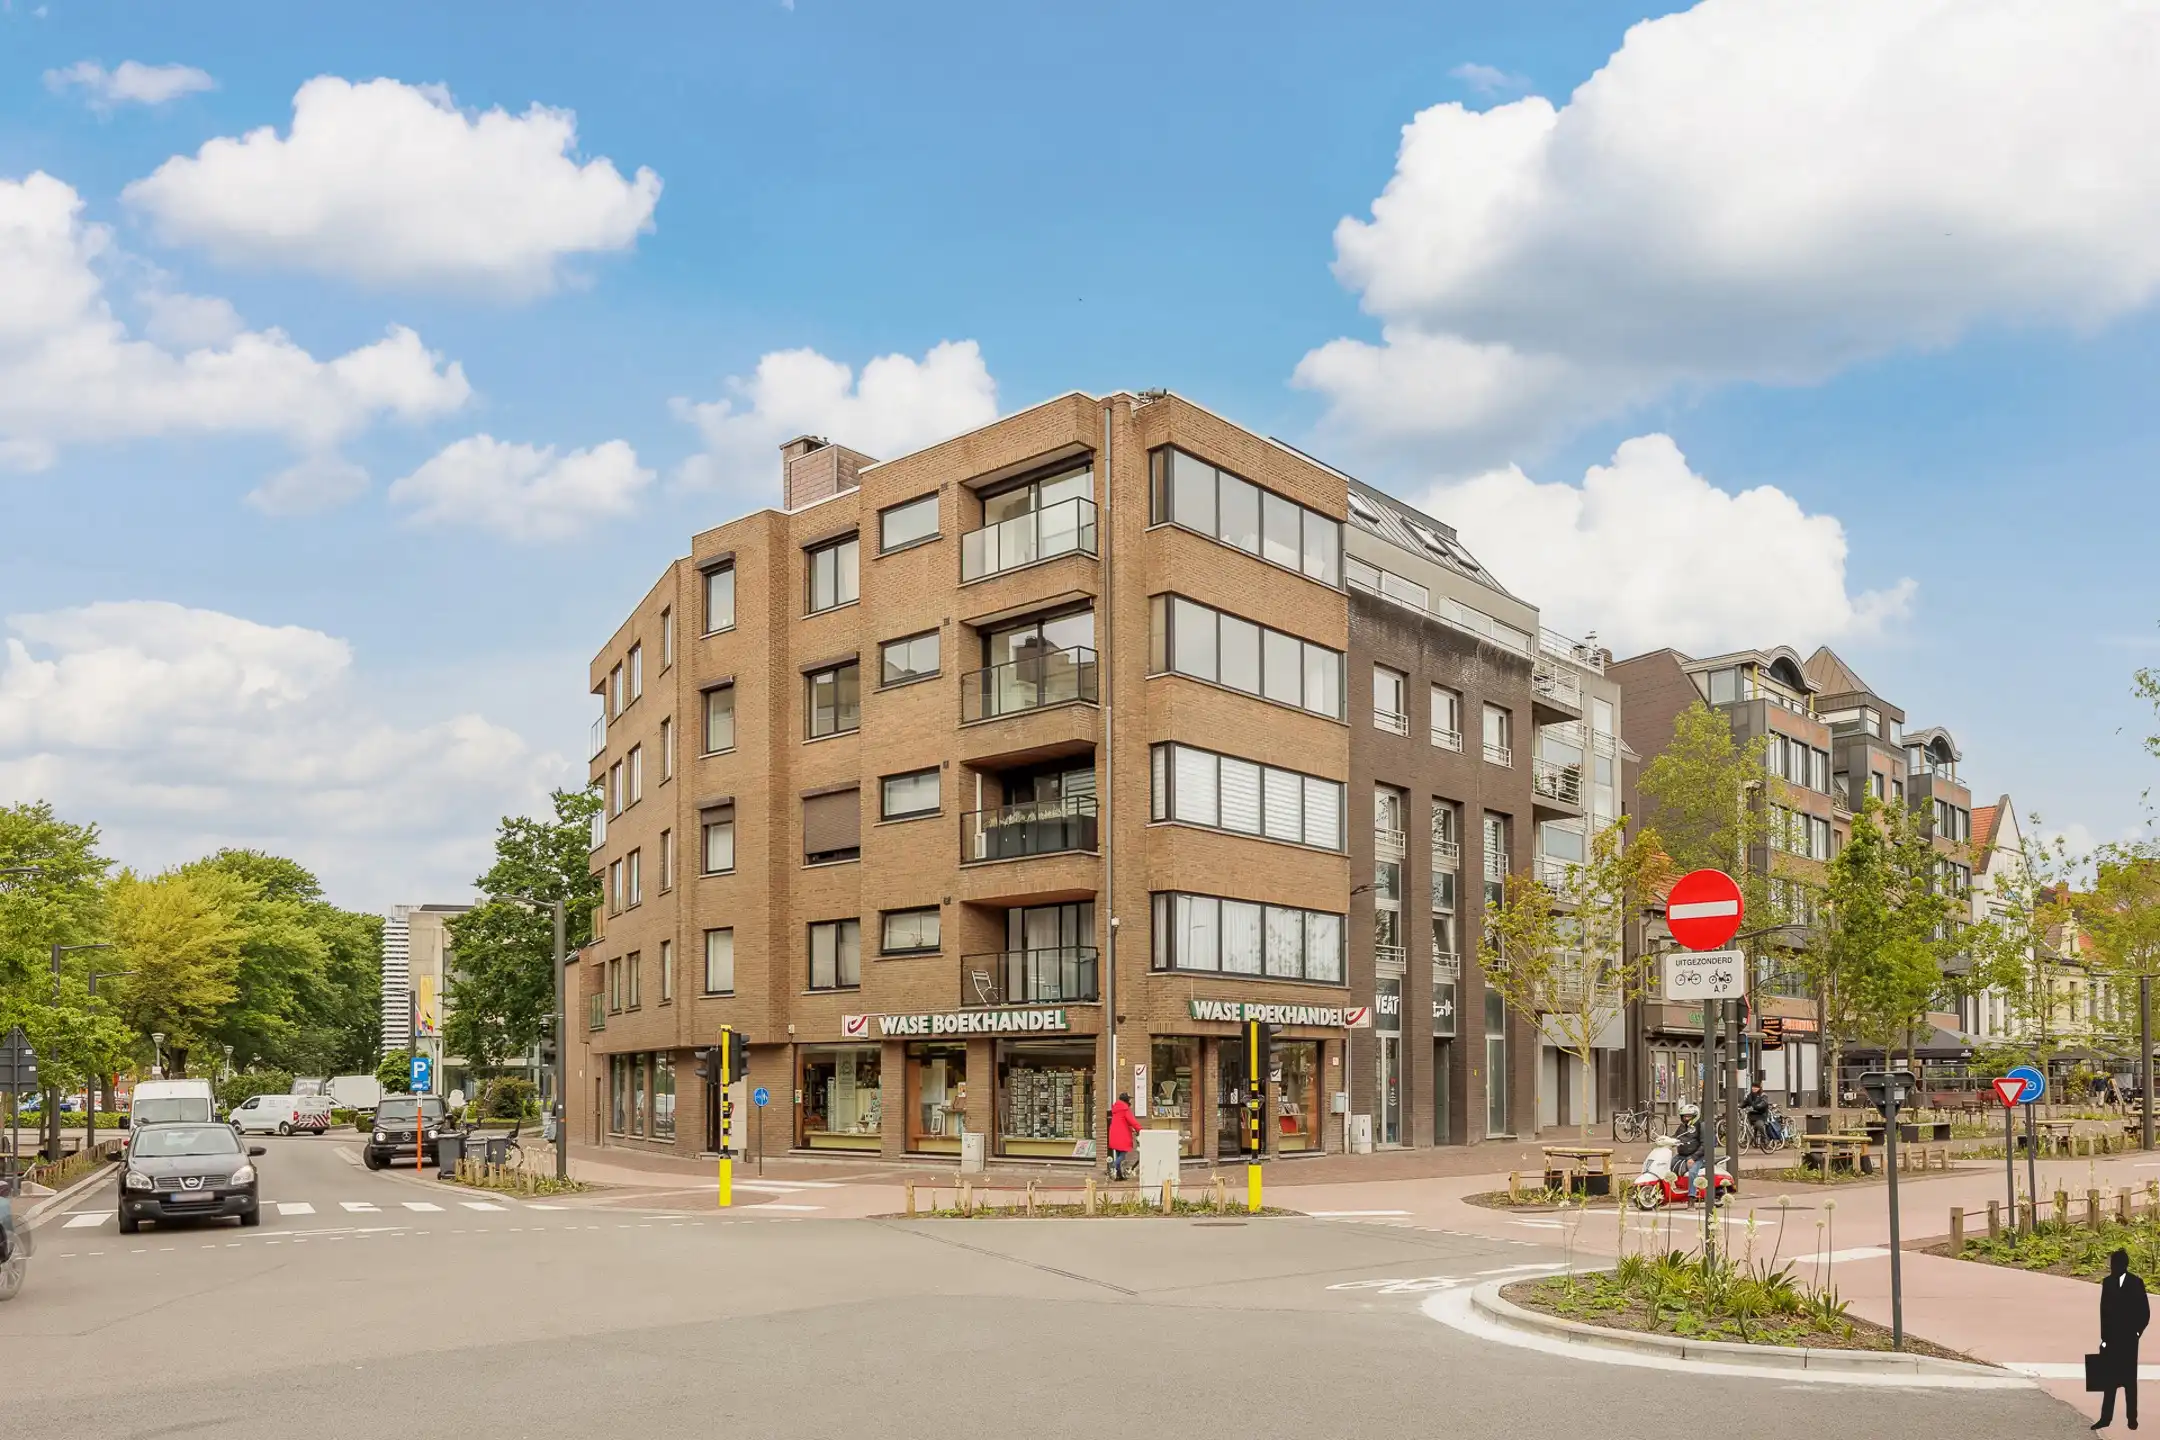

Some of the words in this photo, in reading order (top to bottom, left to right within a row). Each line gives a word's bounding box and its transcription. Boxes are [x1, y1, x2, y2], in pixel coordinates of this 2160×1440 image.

[1675, 956, 1733, 967] UITGEZONDERD
[1722, 984, 1728, 992] P
[1192, 1001, 1240, 1021] WASE
[1244, 1003, 1345, 1026] BOEKHANDEL
[878, 1015, 931, 1035] WASE
[932, 1010, 1067, 1034] BOEKHANDEL
[413, 1061, 426, 1078] P
